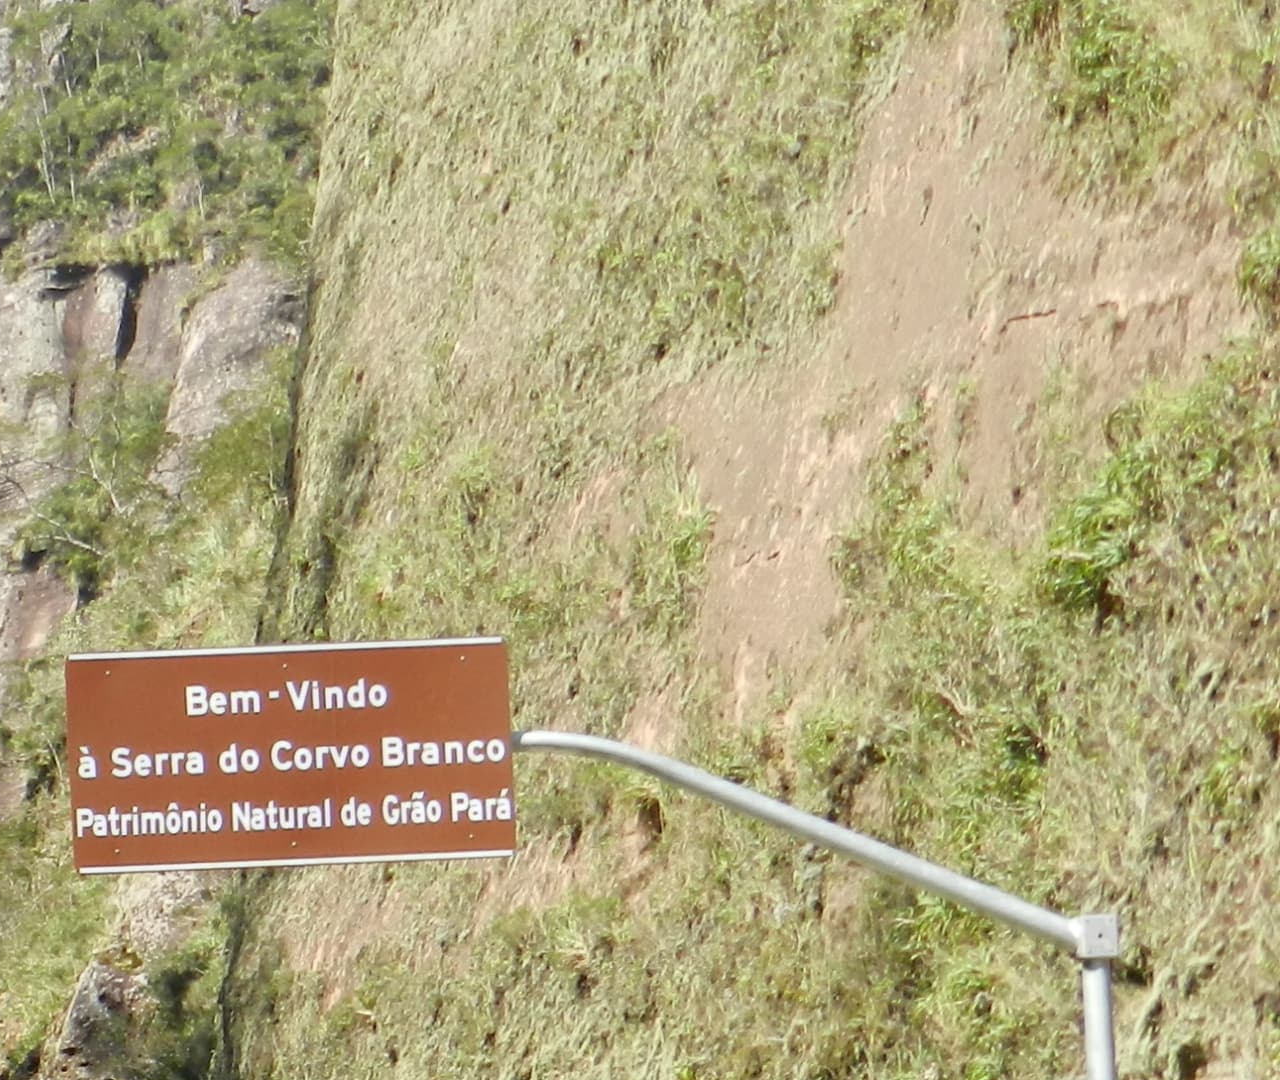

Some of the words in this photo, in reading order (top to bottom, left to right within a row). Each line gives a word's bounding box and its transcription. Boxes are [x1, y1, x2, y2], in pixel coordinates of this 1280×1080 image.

[79, 746, 99, 778] à
[112, 747, 206, 777] Serra
[219, 743, 261, 773] do
[271, 740, 371, 770] Corvo
[382, 736, 506, 766] Branco
[77, 802, 224, 837] Patrimônio
[232, 798, 332, 831] Natural
[341, 797, 373, 826] de
[383, 791, 442, 825] Grão
[451, 788, 512, 822] Pará
